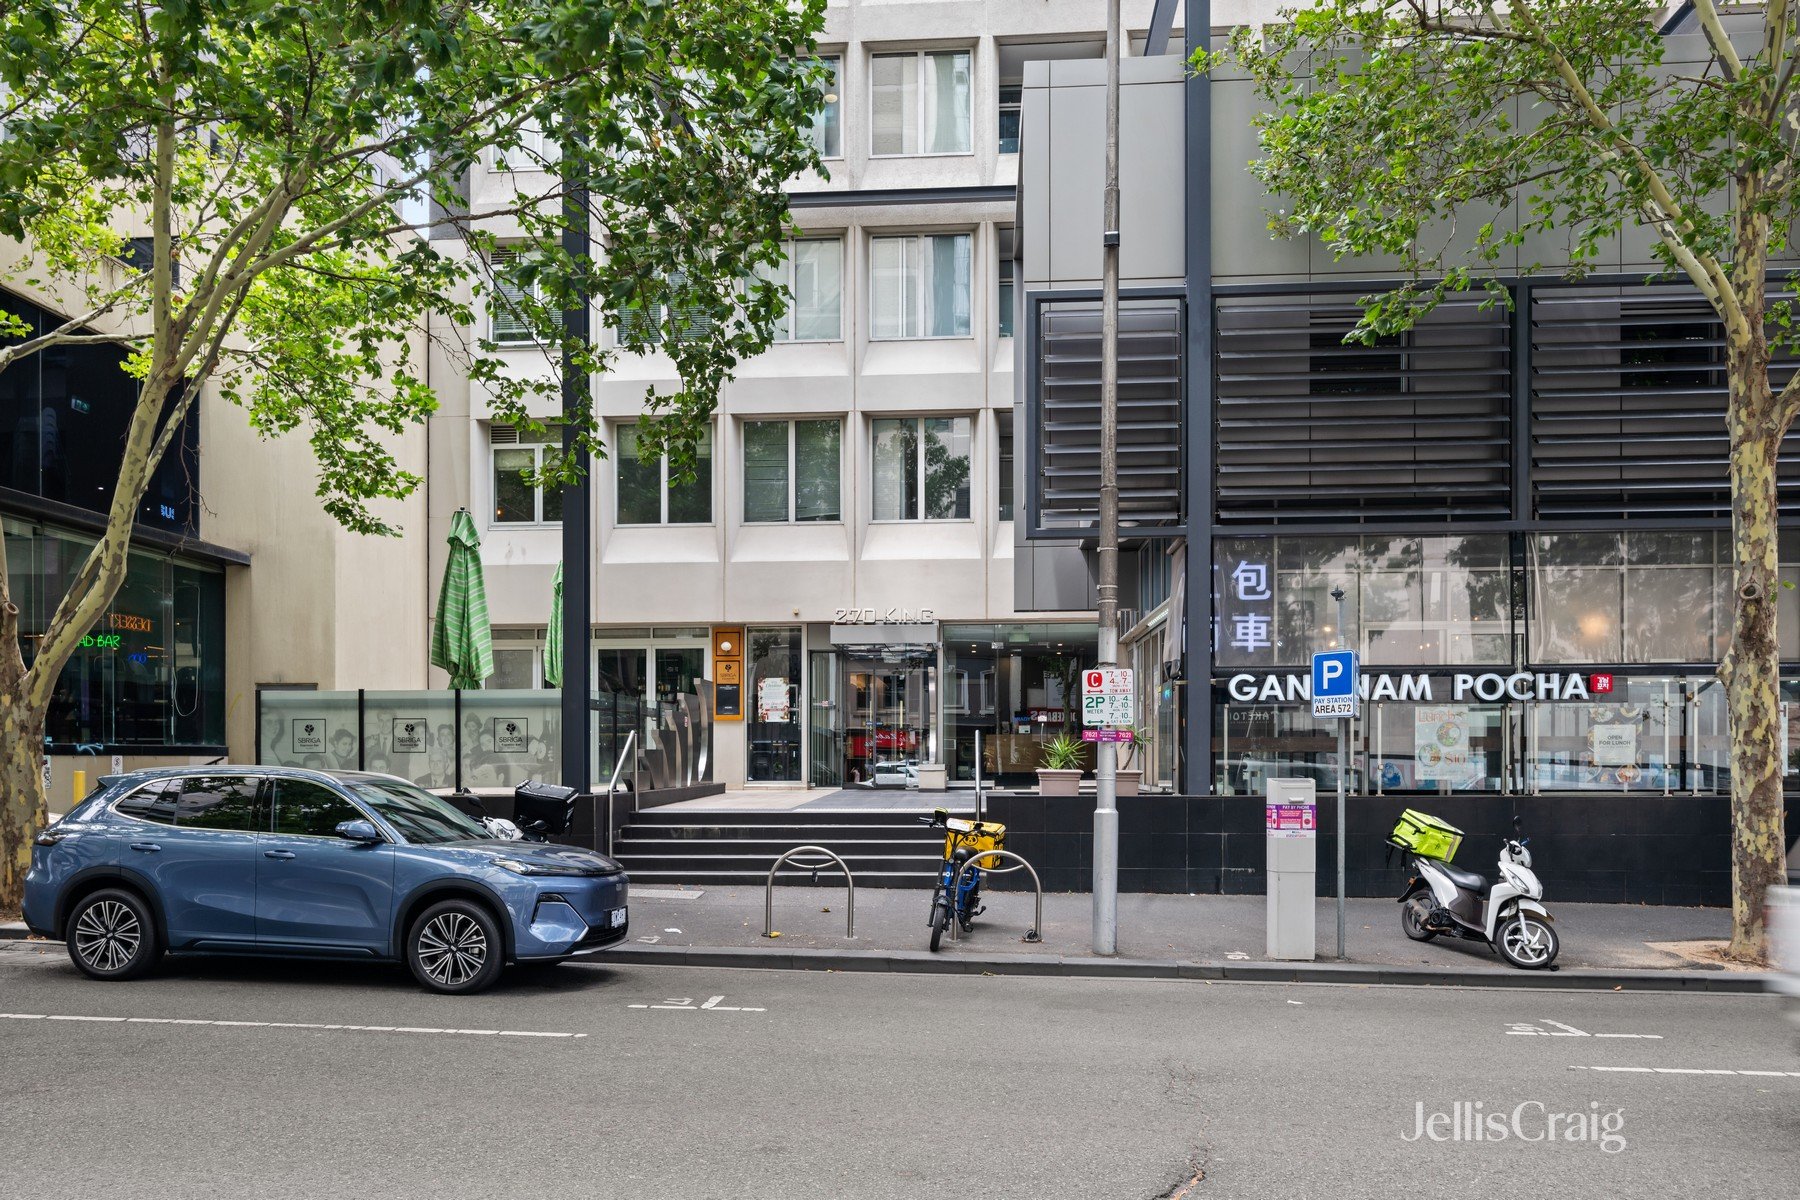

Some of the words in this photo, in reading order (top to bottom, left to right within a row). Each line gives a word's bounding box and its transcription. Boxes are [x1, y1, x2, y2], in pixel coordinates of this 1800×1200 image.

[1231, 560, 1271, 653] 包車
[834, 608, 876, 625] 270
[883, 608, 934, 625] KING
[78, 635, 94, 647] AD
[97, 635, 120, 647] BAR
[1091, 673, 1099, 687] C
[1322, 660, 1343, 690] P
[1228, 673, 1433, 701] GANNAM
[1453, 672, 1590, 701] POCHA
[1085, 696, 1106, 709] 2P
[1314, 705, 1336, 714] AREA
[1337, 704, 1352, 713] 572
